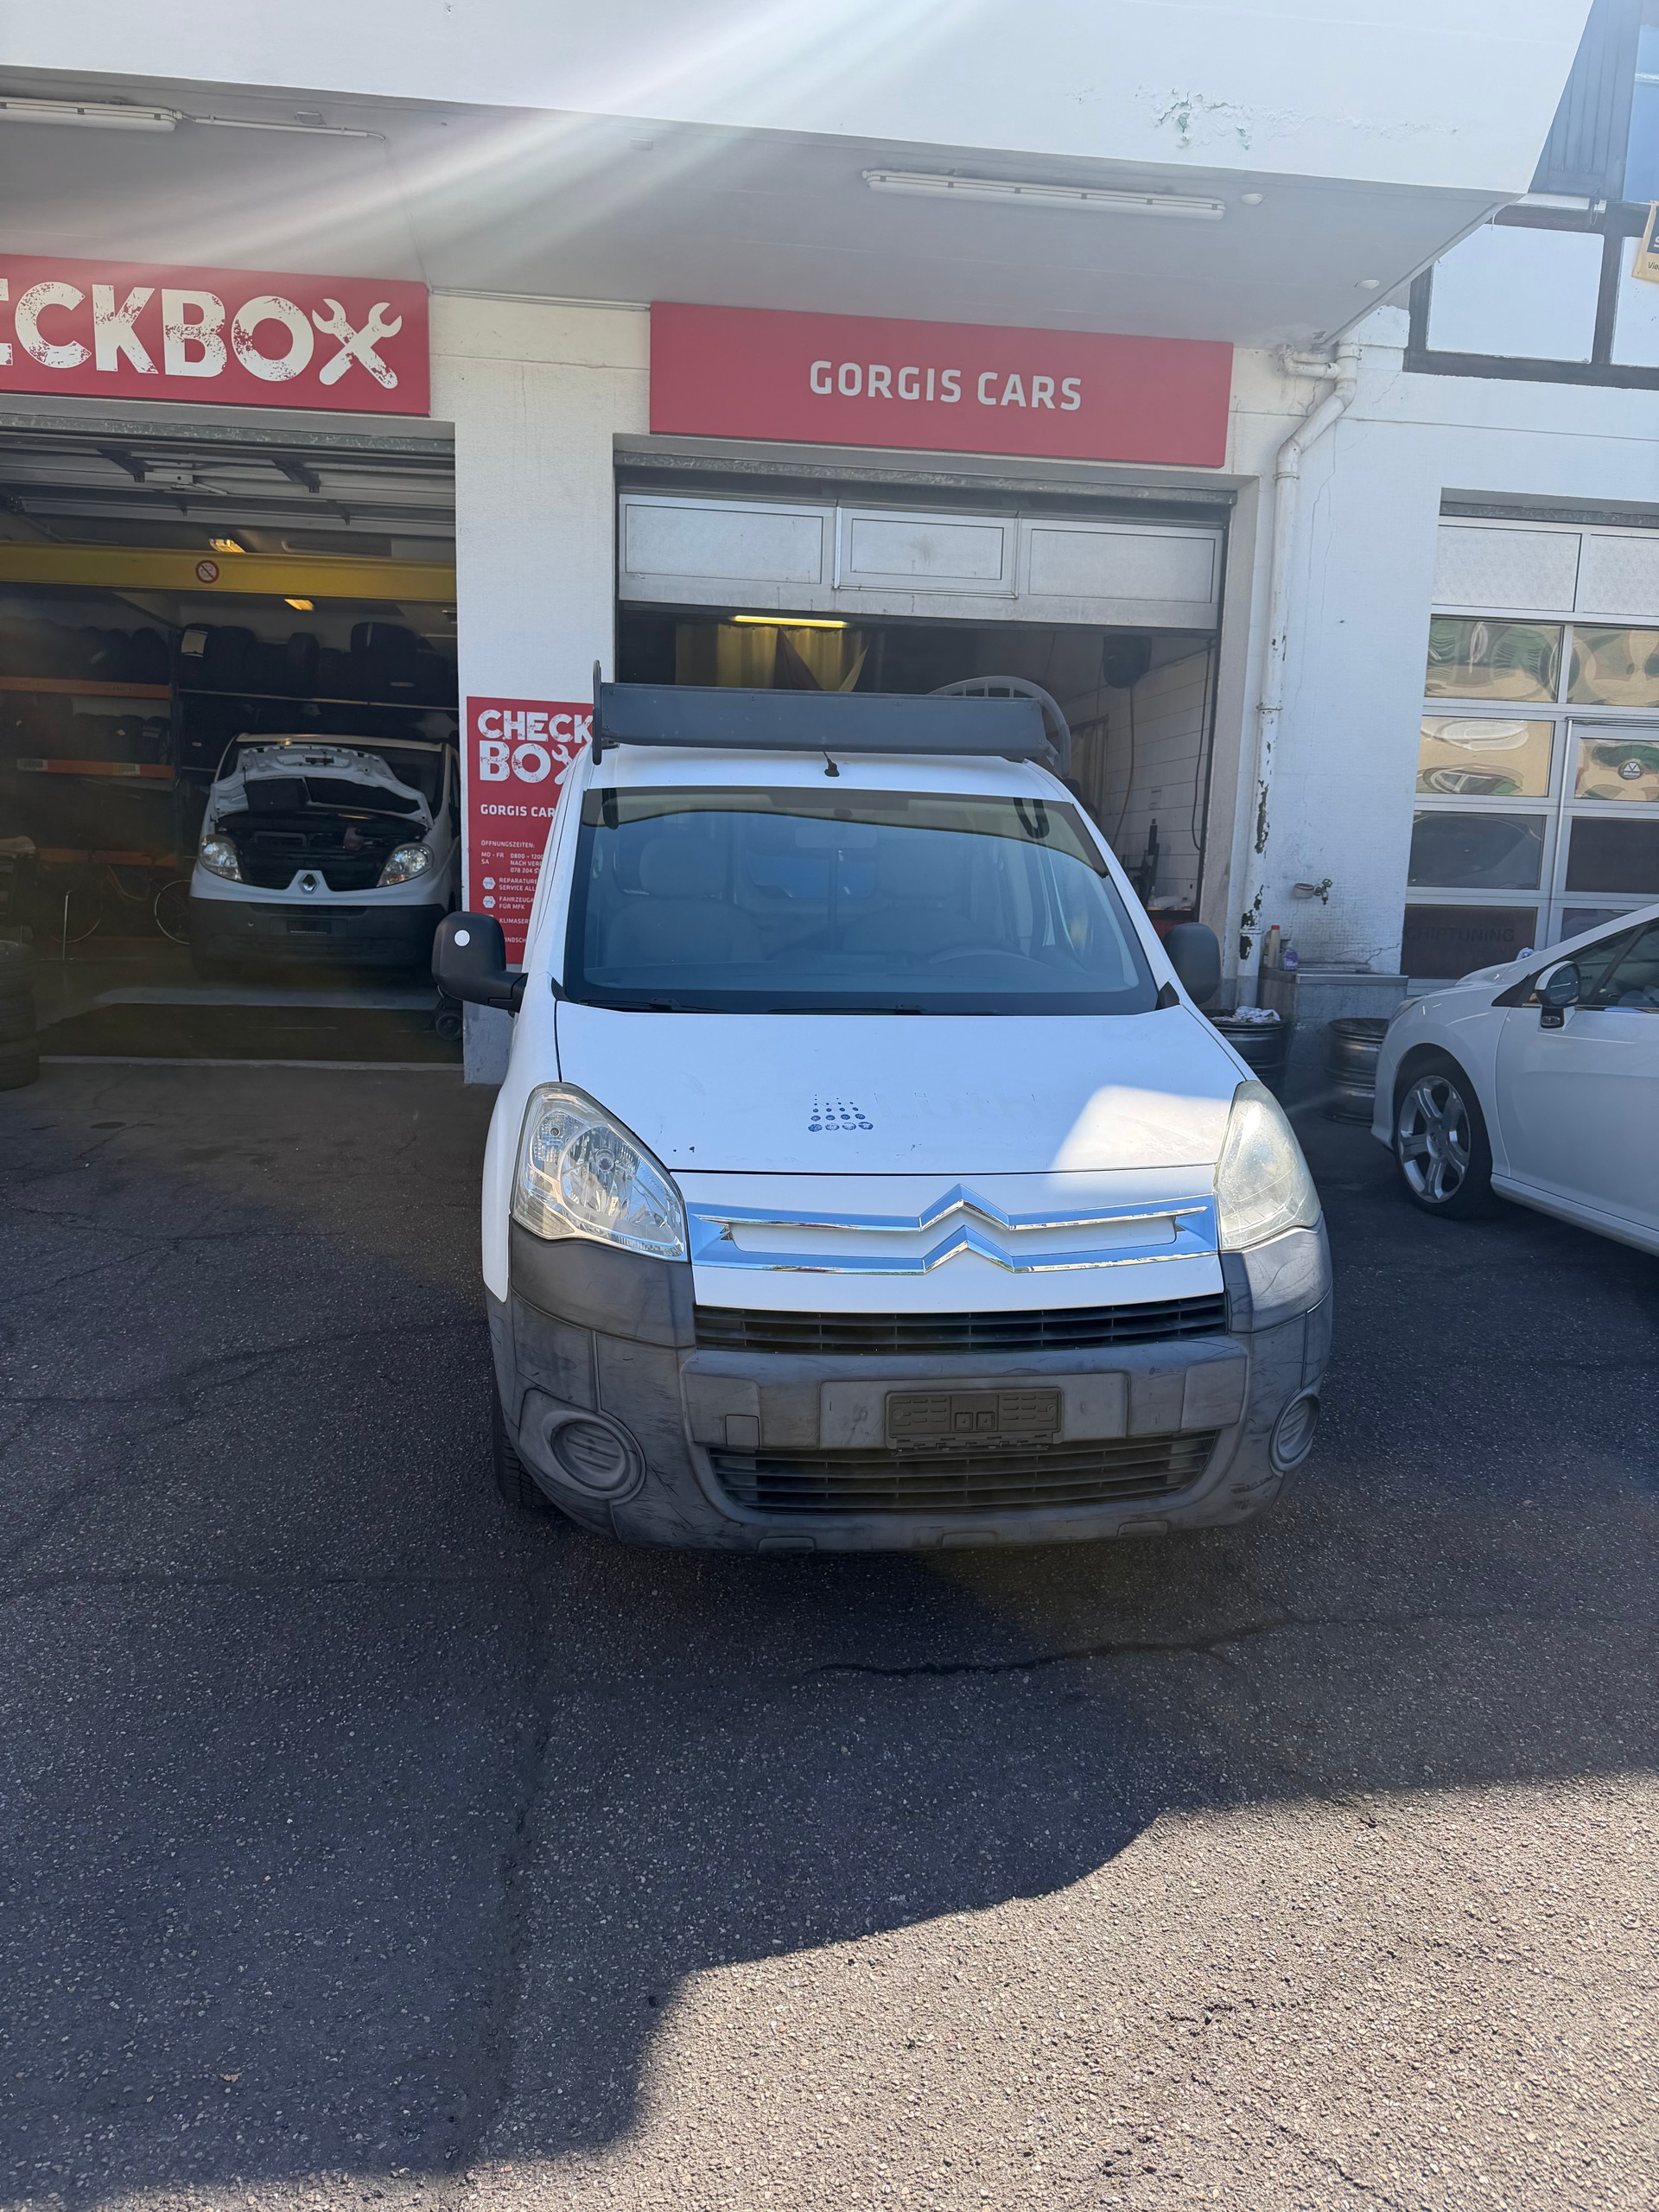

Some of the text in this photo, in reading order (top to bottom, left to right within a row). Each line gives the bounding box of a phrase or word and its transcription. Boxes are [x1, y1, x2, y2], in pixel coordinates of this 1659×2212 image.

[0, 278, 403, 389] CKBOX
[810, 360, 1082, 410] GORGIS CARS
[478, 709, 593, 743] CHECK
[480, 804, 527, 817] GORGIS
[480, 839, 536, 849] ÖFFNUNGSZEITEN:
